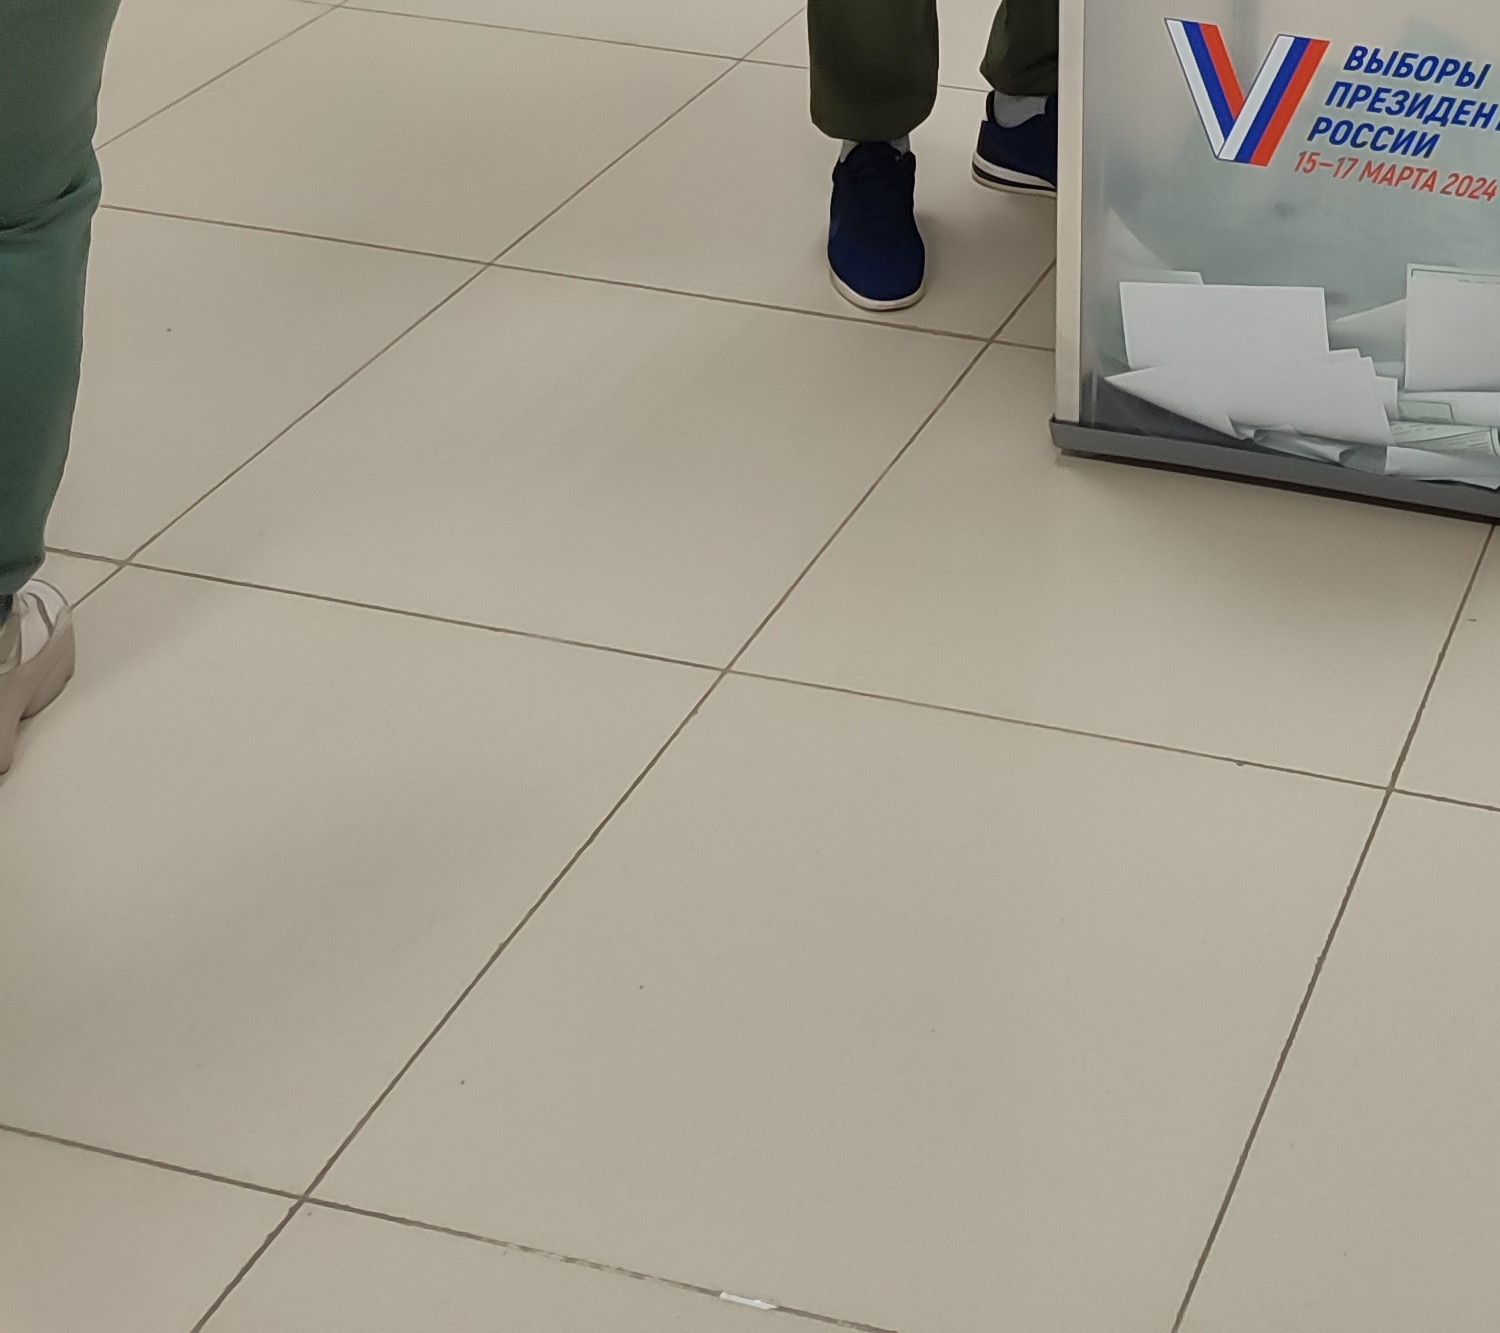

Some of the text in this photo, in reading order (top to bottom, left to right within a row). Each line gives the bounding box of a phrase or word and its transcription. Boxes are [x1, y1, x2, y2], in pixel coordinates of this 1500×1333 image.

[1343, 45, 1492, 89] ВЫБОРЫ
[1307, 116, 1440, 159] РОССИИ
[1358, 160, 1439, 193] МАРТА
[1440, 173, 1498, 201] 2024
